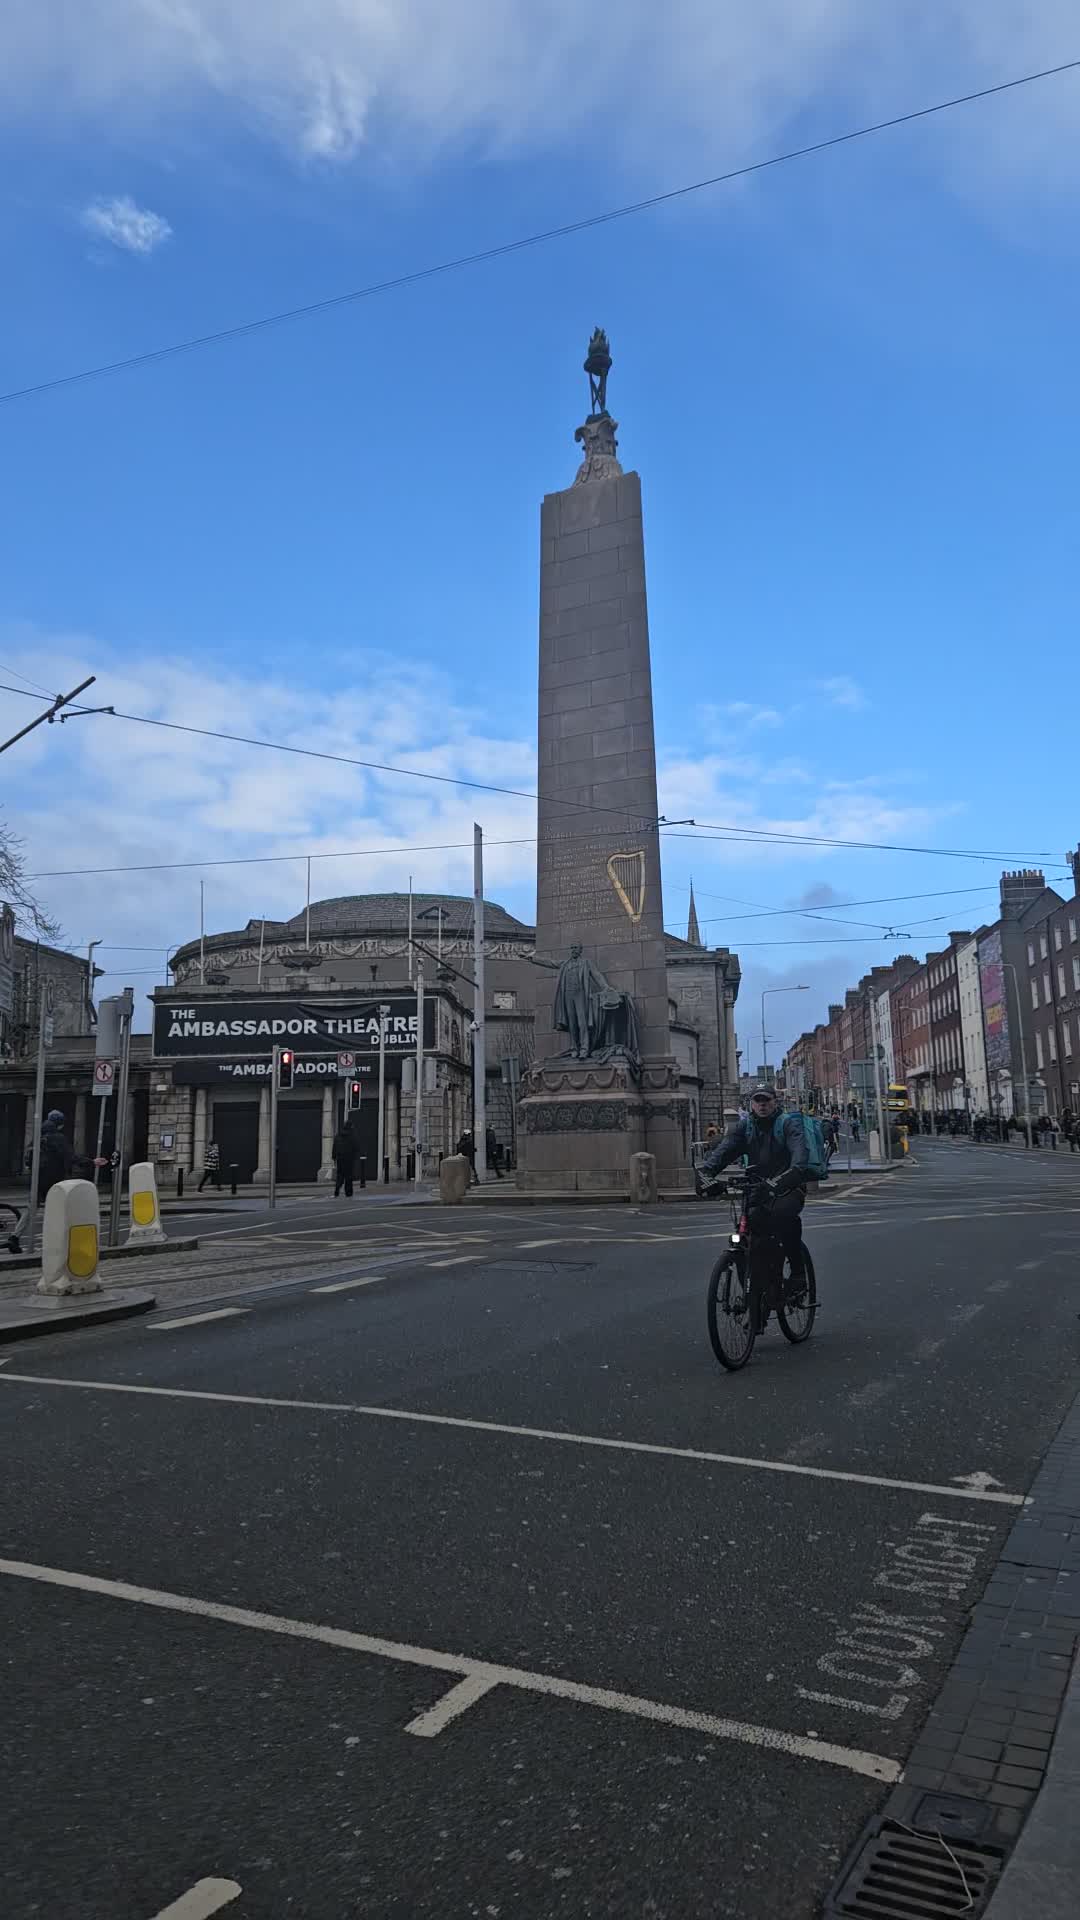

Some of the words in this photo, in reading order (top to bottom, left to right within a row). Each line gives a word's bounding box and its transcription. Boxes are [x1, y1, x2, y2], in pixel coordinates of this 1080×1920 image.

[170, 1009, 196, 1019] THE
[168, 1019, 318, 1038] AMBASSADOR
[323, 1016, 418, 1035] THEATRE
[232, 1062, 338, 1076] AMBAADOR
[794, 1602, 947, 1720] LOOK
[871, 1512, 997, 1600] RIGHT
